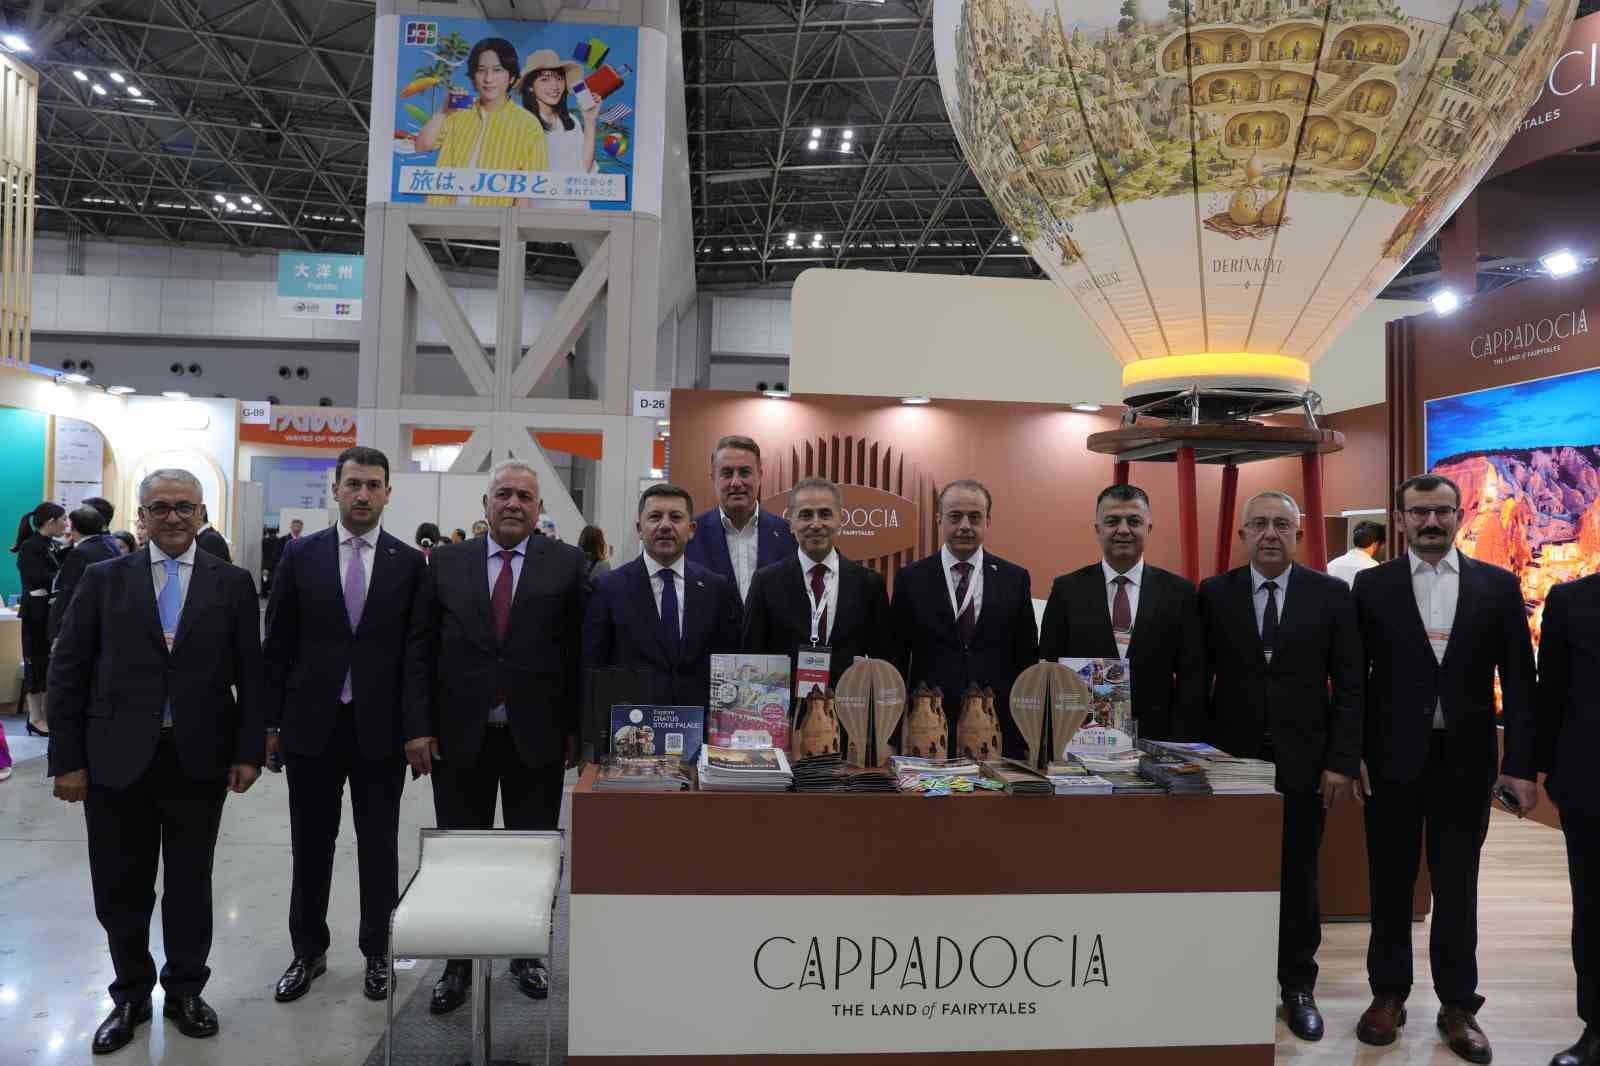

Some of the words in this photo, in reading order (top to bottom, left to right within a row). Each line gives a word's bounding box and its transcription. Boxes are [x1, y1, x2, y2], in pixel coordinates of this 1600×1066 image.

[295, 261, 353, 280] 大洋州
[1471, 308, 1588, 359] CAPPADOCIA
[242, 408, 265, 417] G-09
[640, 399, 665, 409] D-26
[753, 933, 1109, 990] CAPPADOCIA
[832, 1004, 864, 1017] THE
[871, 1003, 917, 1016] LAND
[921, 1001, 937, 1020] of
[941, 1002, 1037, 1016] FAIRYTALES
